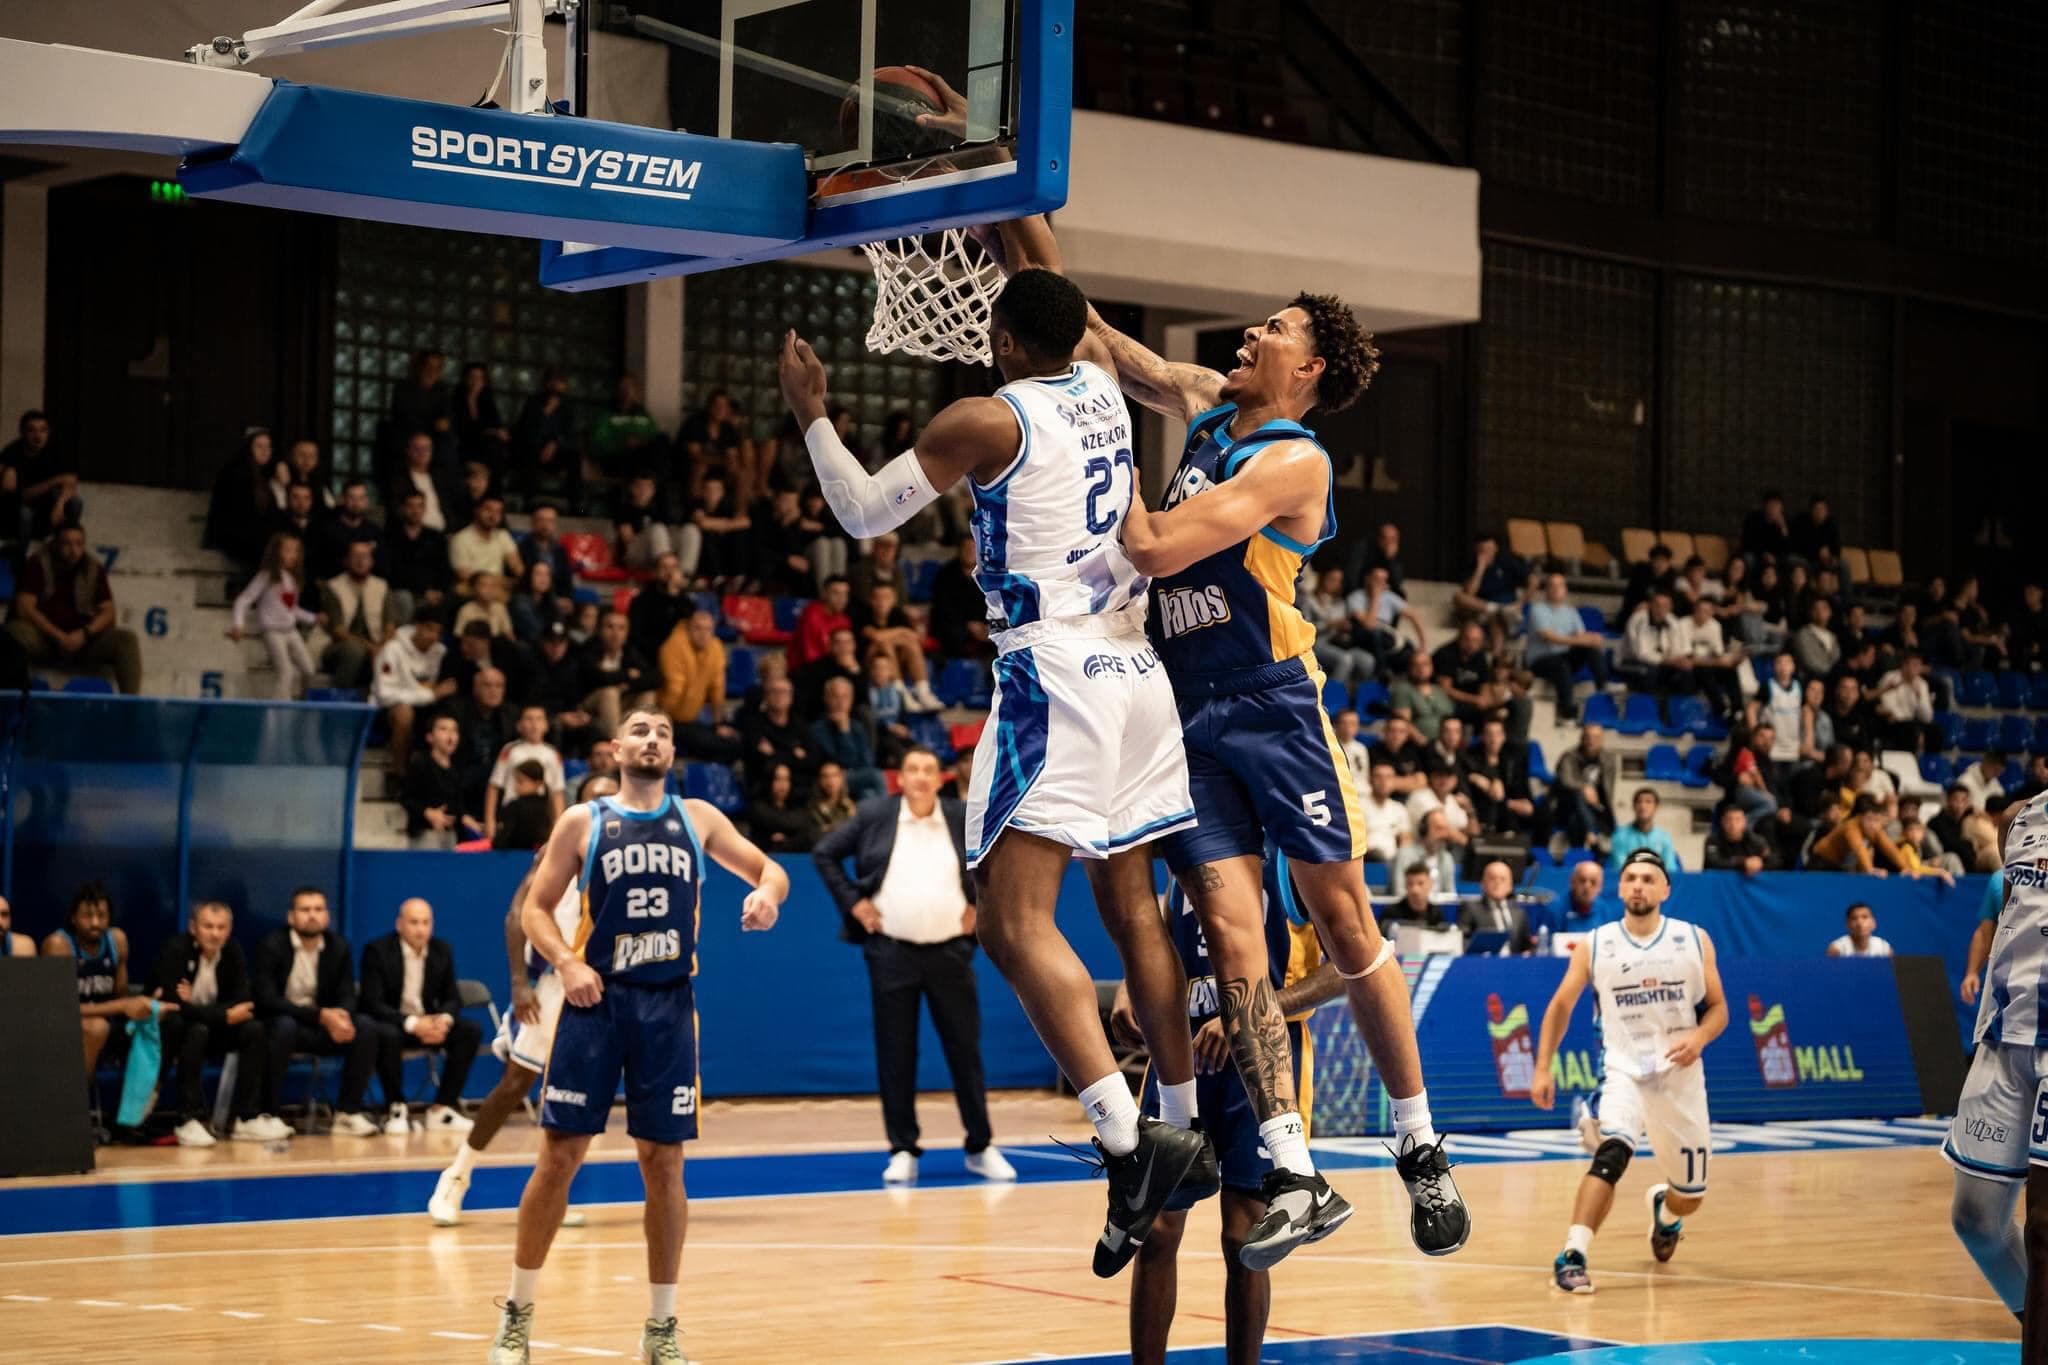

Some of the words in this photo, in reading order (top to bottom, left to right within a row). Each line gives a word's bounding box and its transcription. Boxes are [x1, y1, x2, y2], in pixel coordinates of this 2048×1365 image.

[144, 607, 169, 637] 6
[202, 672, 223, 699] 5
[1302, 789, 1332, 827] 5
[601, 843, 692, 885] BORA
[626, 887, 669, 919] 23
[1795, 1045, 1864, 1082] MALL
